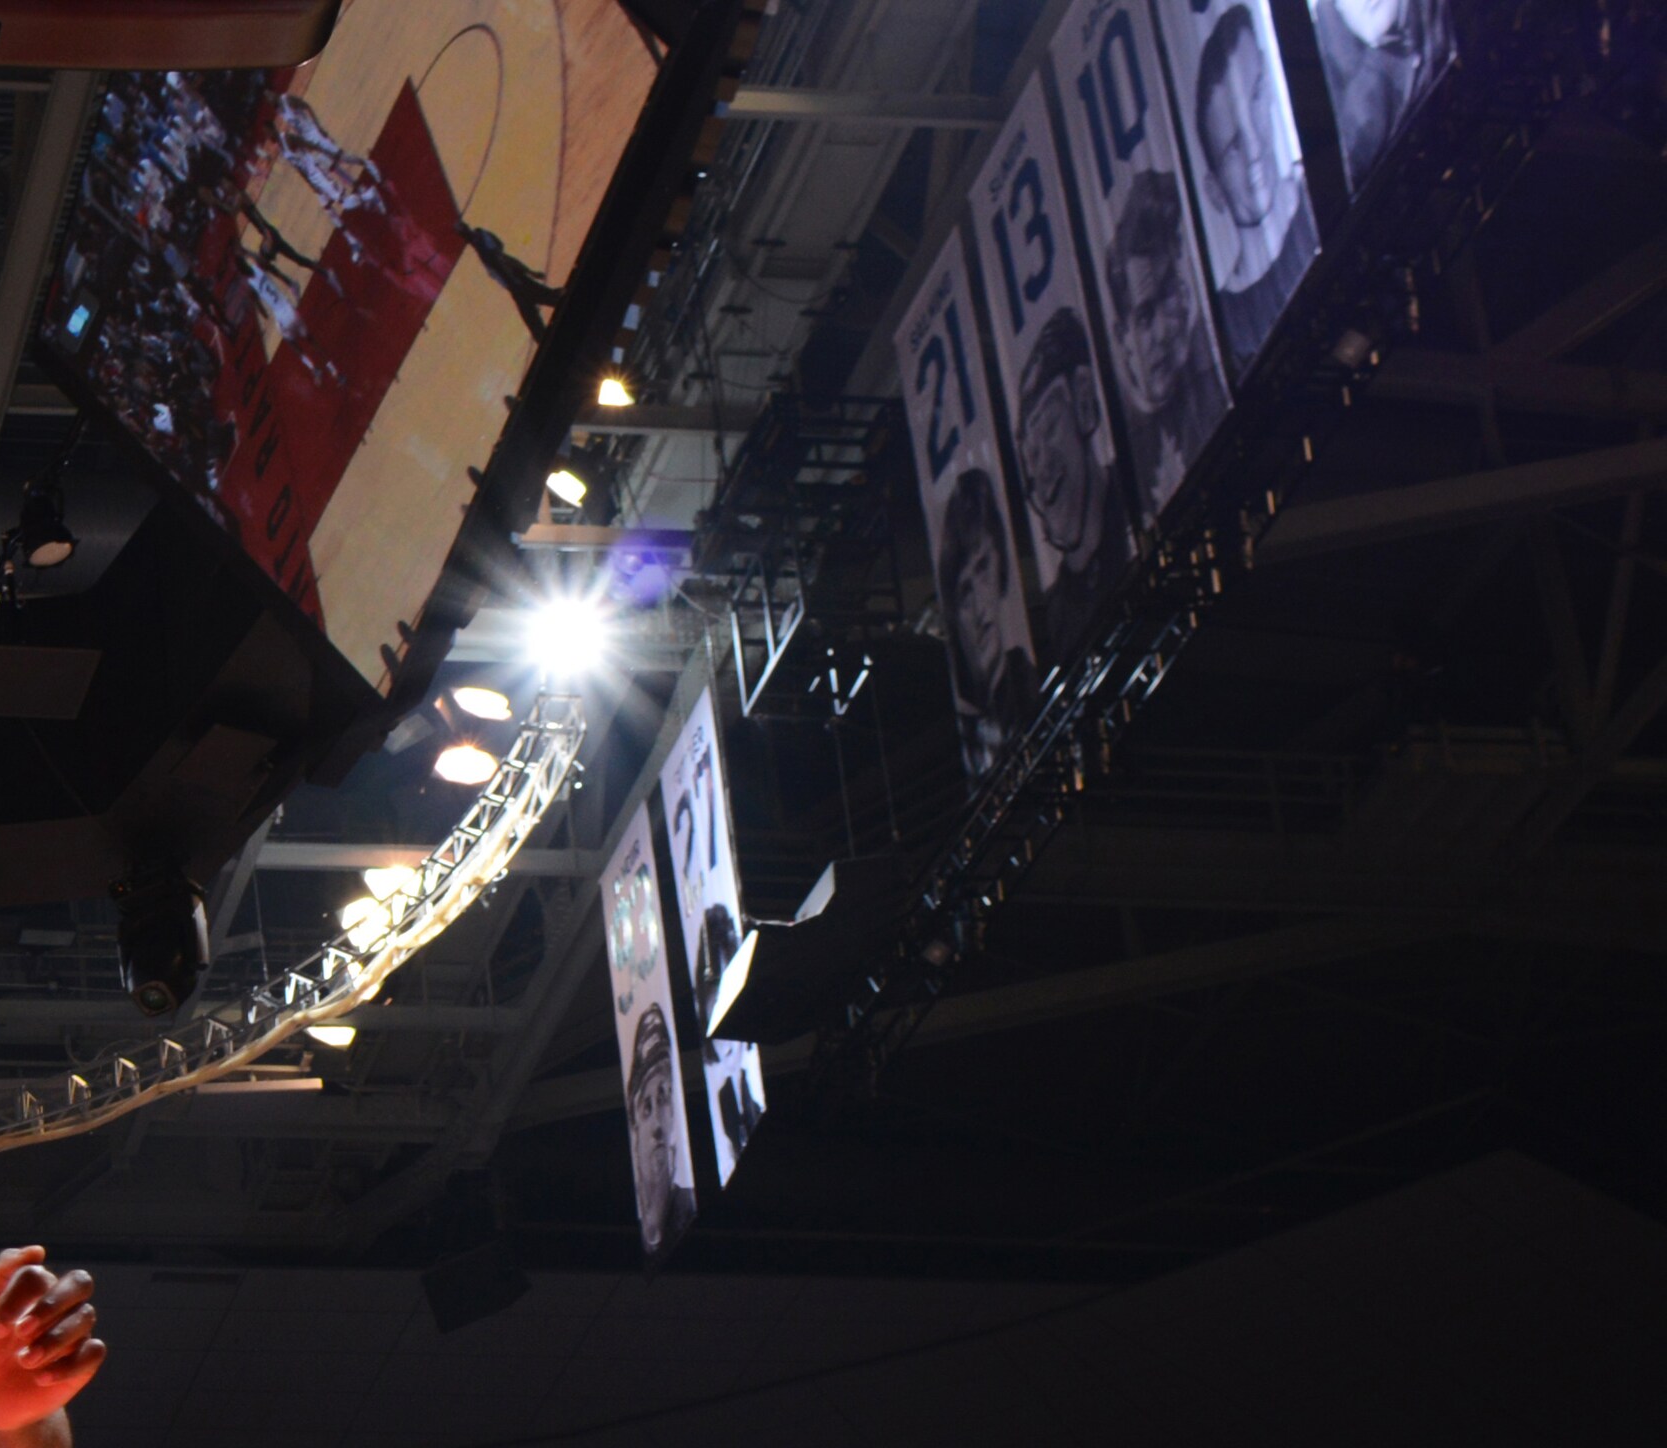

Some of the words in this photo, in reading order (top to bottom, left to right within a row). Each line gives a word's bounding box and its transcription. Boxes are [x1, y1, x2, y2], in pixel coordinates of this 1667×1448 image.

[1078, 8, 1148, 200] 10
[993, 157, 1055, 335] 13
[917, 297, 976, 484] 21
